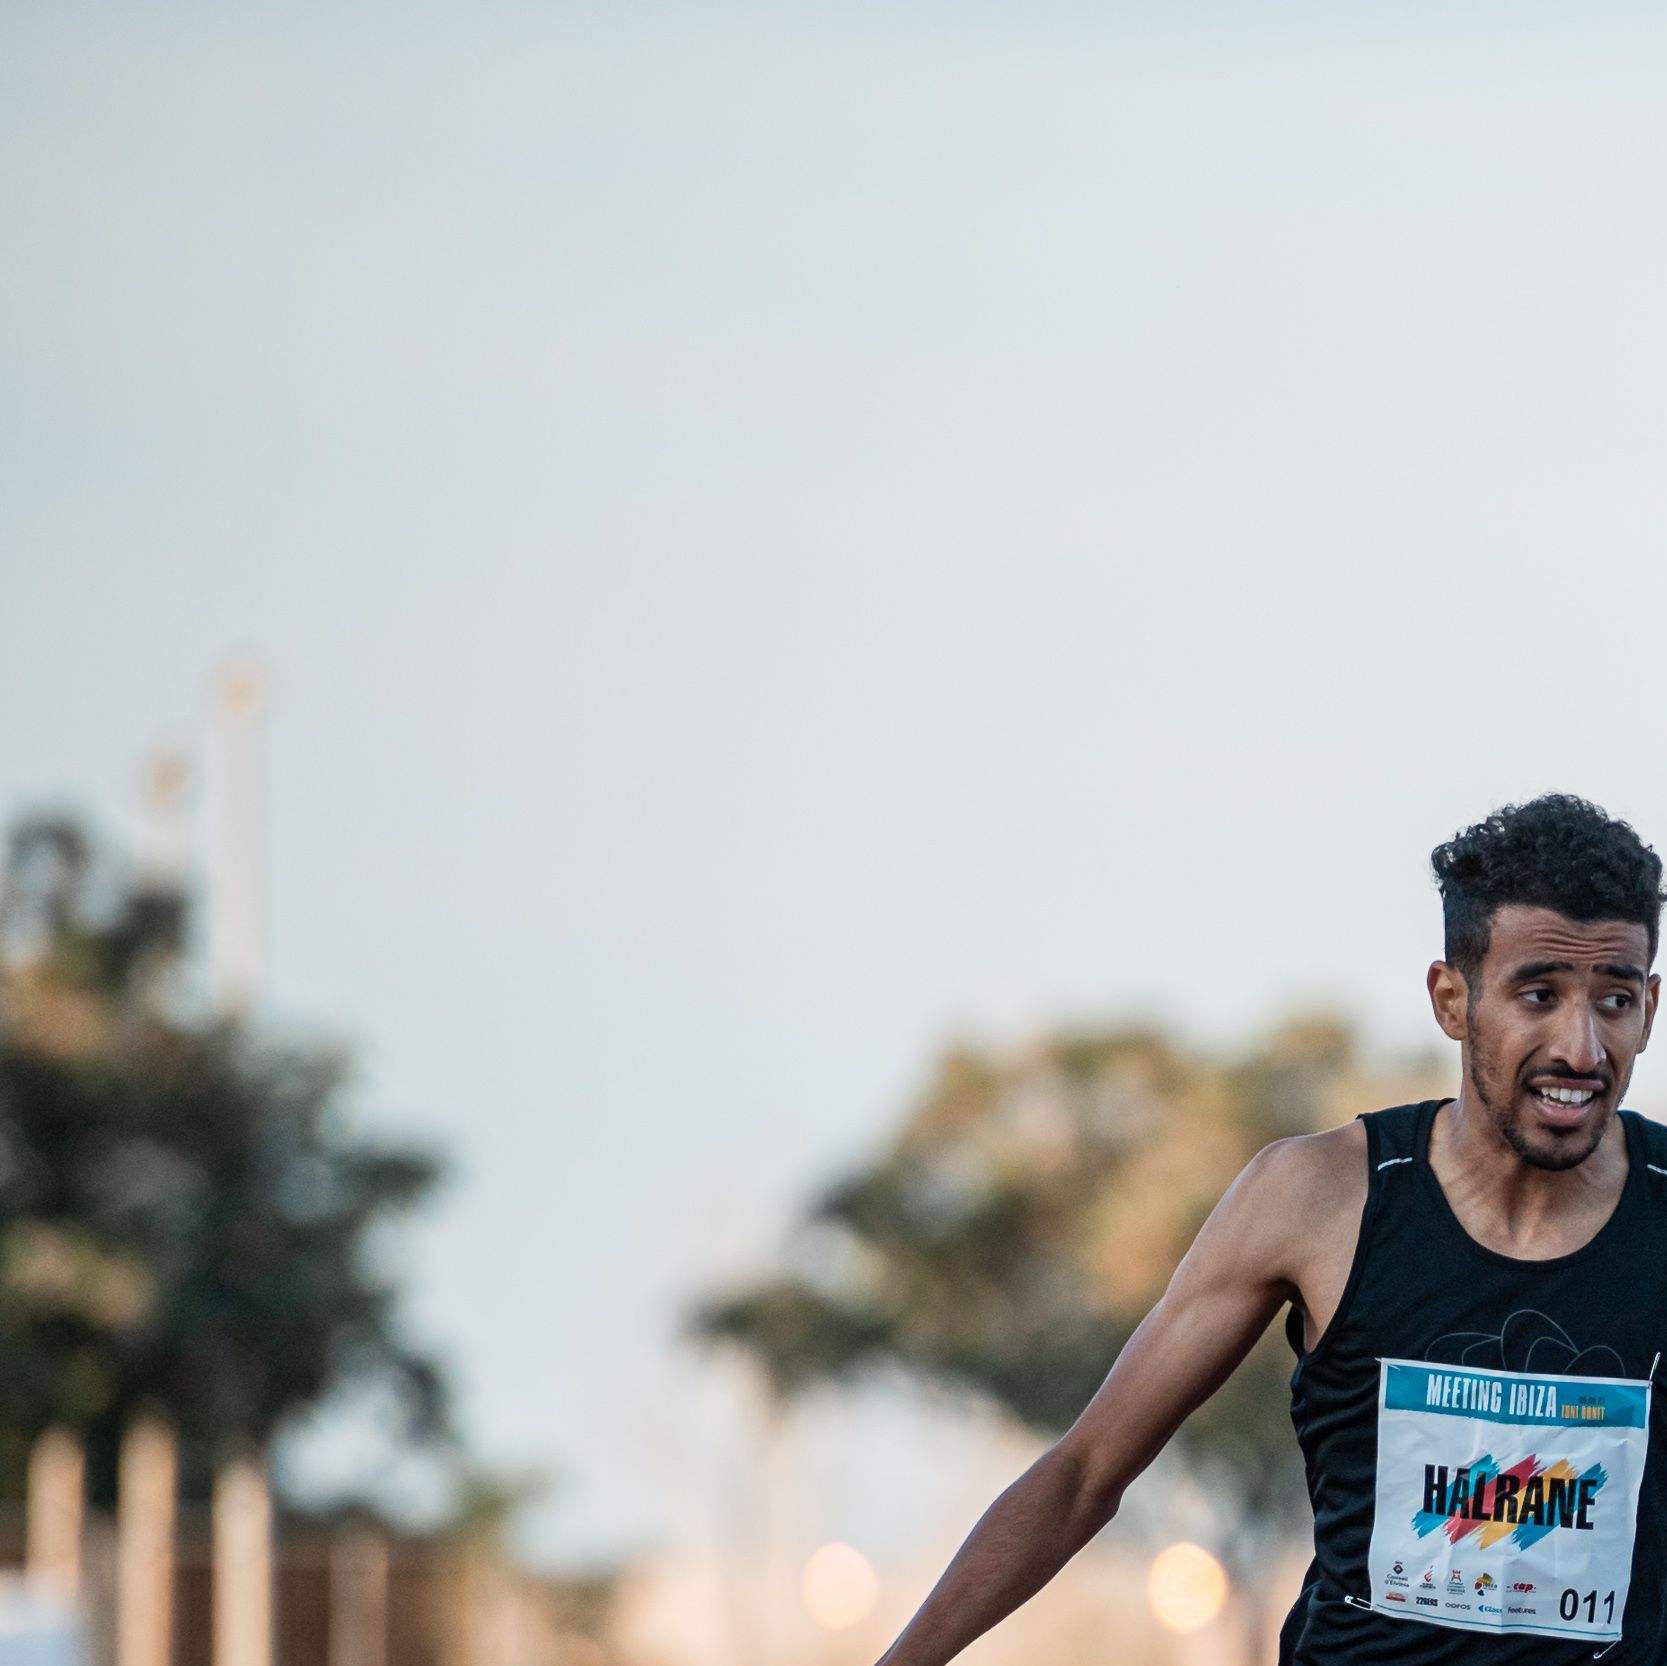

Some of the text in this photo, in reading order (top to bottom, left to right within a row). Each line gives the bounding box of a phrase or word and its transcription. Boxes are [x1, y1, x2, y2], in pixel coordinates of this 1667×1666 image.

[1426, 1374, 1557, 1418] MEETING IBIZA
[1422, 1464, 1598, 1530] HALRANE
[1559, 1588, 1615, 1624] 011
